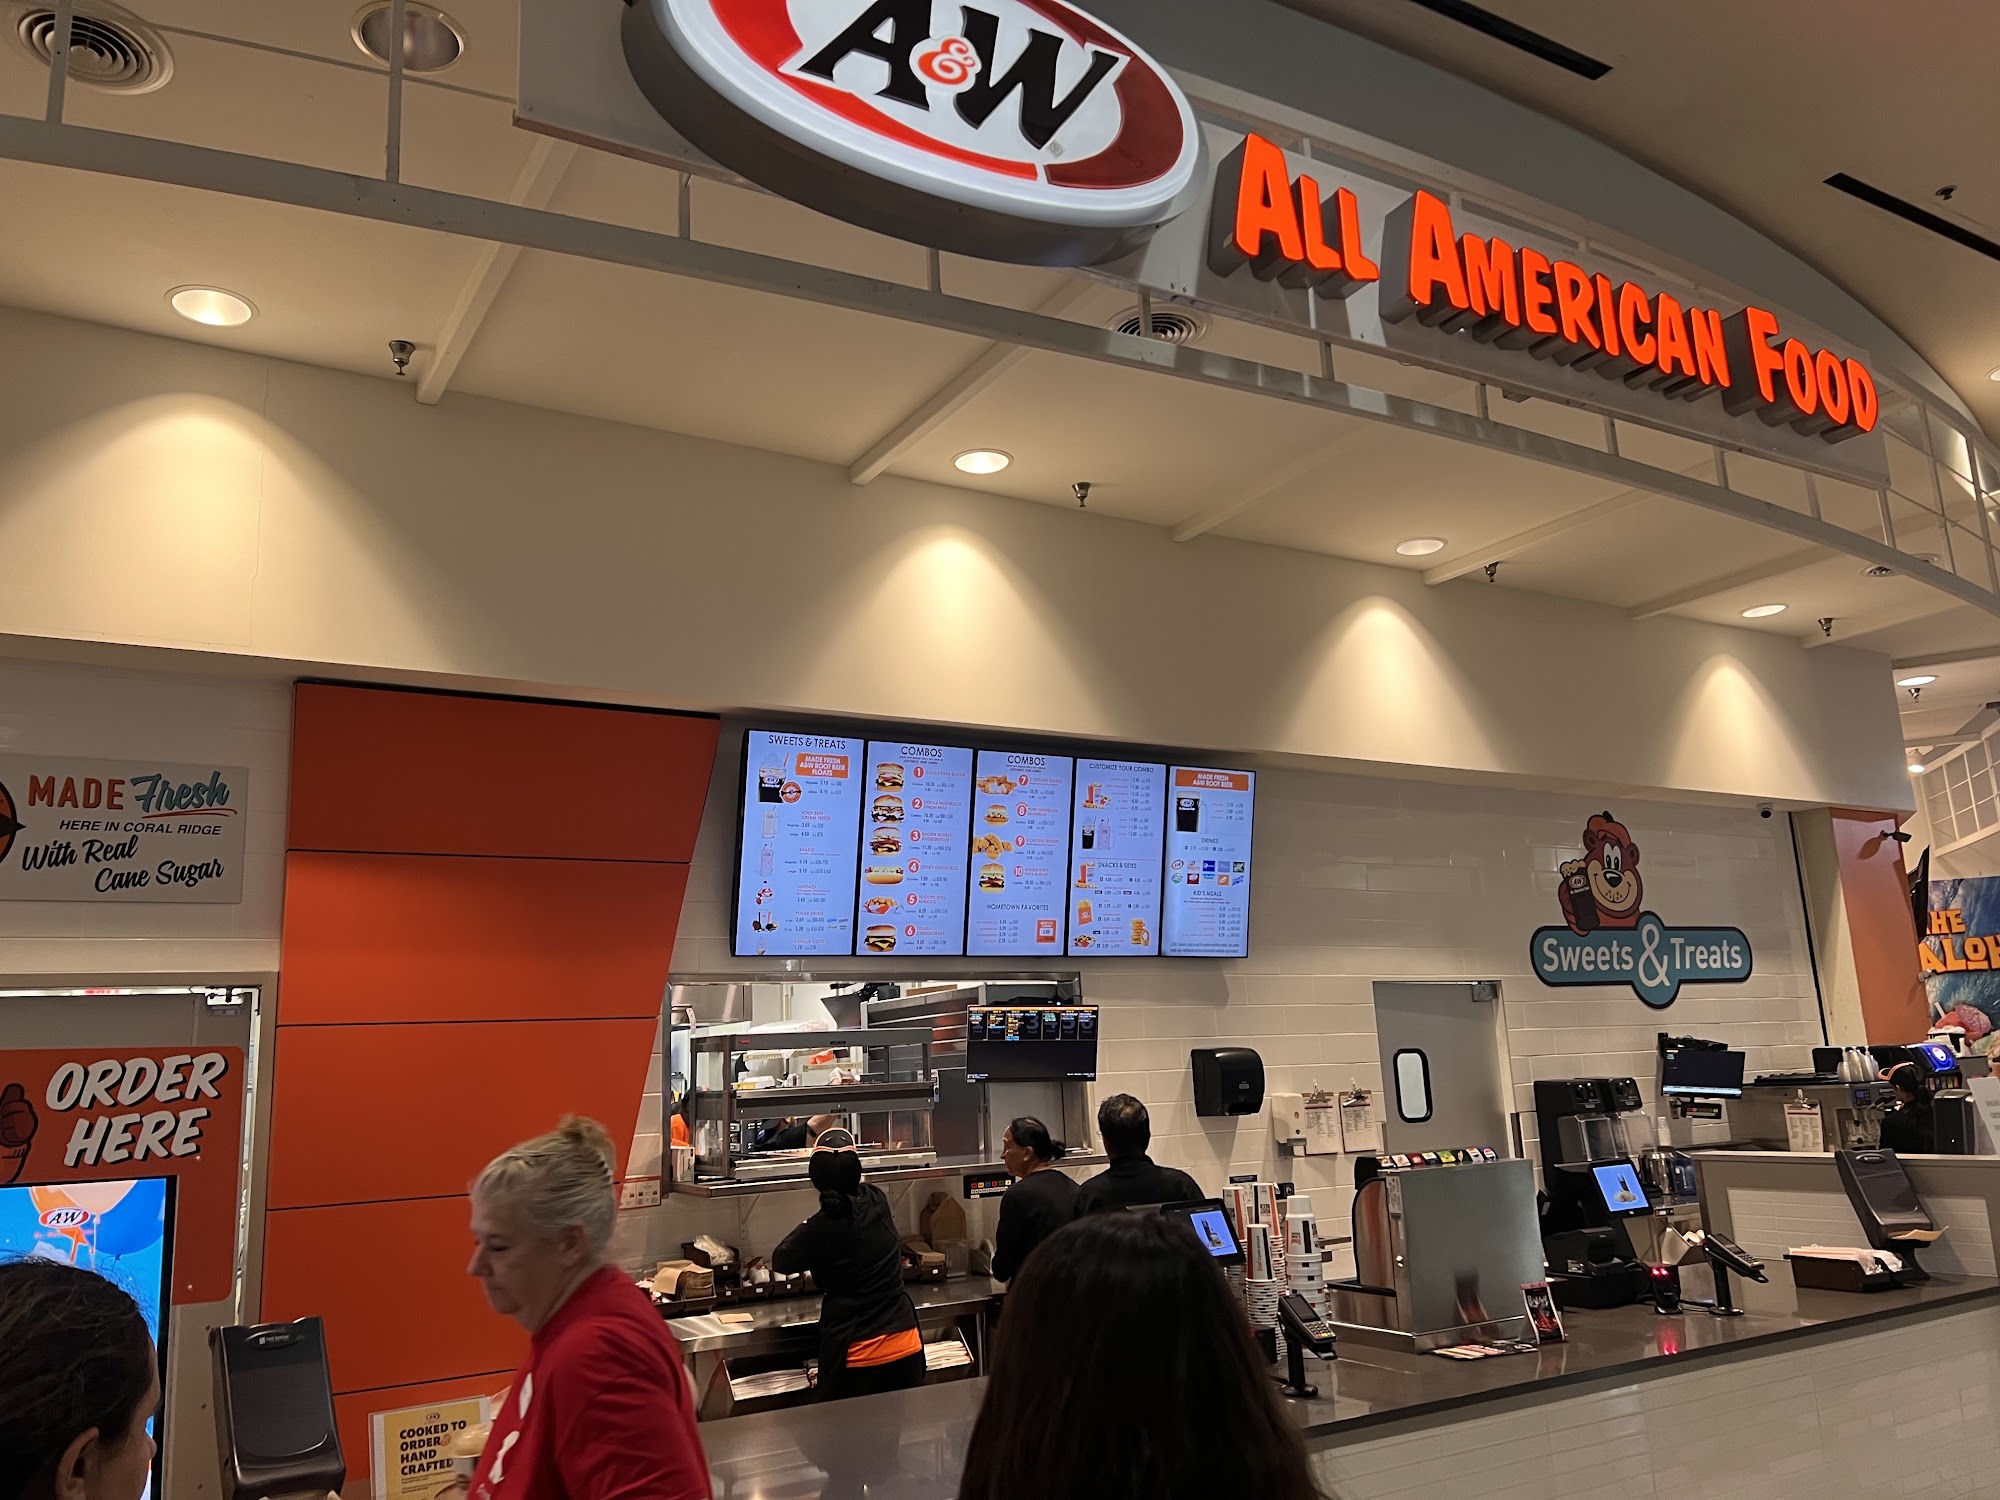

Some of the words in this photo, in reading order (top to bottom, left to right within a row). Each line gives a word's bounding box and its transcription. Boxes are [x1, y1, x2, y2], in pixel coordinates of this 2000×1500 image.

[798, 0, 1119, 149] A&W
[1236, 133, 1379, 282] ALL
[1408, 189, 1730, 387] AMERICAN
[1747, 306, 1878, 432] FOOD
[769, 734, 803, 747] SWEETS
[805, 738, 812, 747] &
[814, 738, 846, 750] TREATS
[900, 746, 943, 758] COMBOS
[1007, 755, 1046, 766] COMBOS
[814, 762, 831, 770] ROOT
[832, 763, 846, 771] BEER
[28, 775, 126, 810] MADE
[130, 771, 230, 812] Fresh
[59, 819, 102, 831] HERE
[104, 821, 121, 832] IN
[123, 822, 174, 834] CORAL
[177, 823, 222, 835] RIDGE
[22, 839, 79, 871] With
[82, 834, 139, 863] Real
[1014, 867, 1023, 876] 10
[1097, 861, 1119, 869] SNACKS
[94, 867, 151, 893] Cane
[155, 858, 224, 887] Sugar
[986, 903, 1020, 911] HOMETOWN
[1926, 909, 1966, 935] HE
[1542, 938, 1634, 972] Sweets
[1638, 923, 1671, 987] &
[1670, 937, 1743, 970] Treats
[46, 1052, 228, 1111] ORDER
[64, 1107, 210, 1167] HERE
[399, 1423, 449, 1440] COOKED
[450, 1420, 467, 1431] TO
[400, 1436, 441, 1451] ORDER
[400, 1449, 437, 1464] HAND
[400, 1458, 454, 1476] CRAFTED
